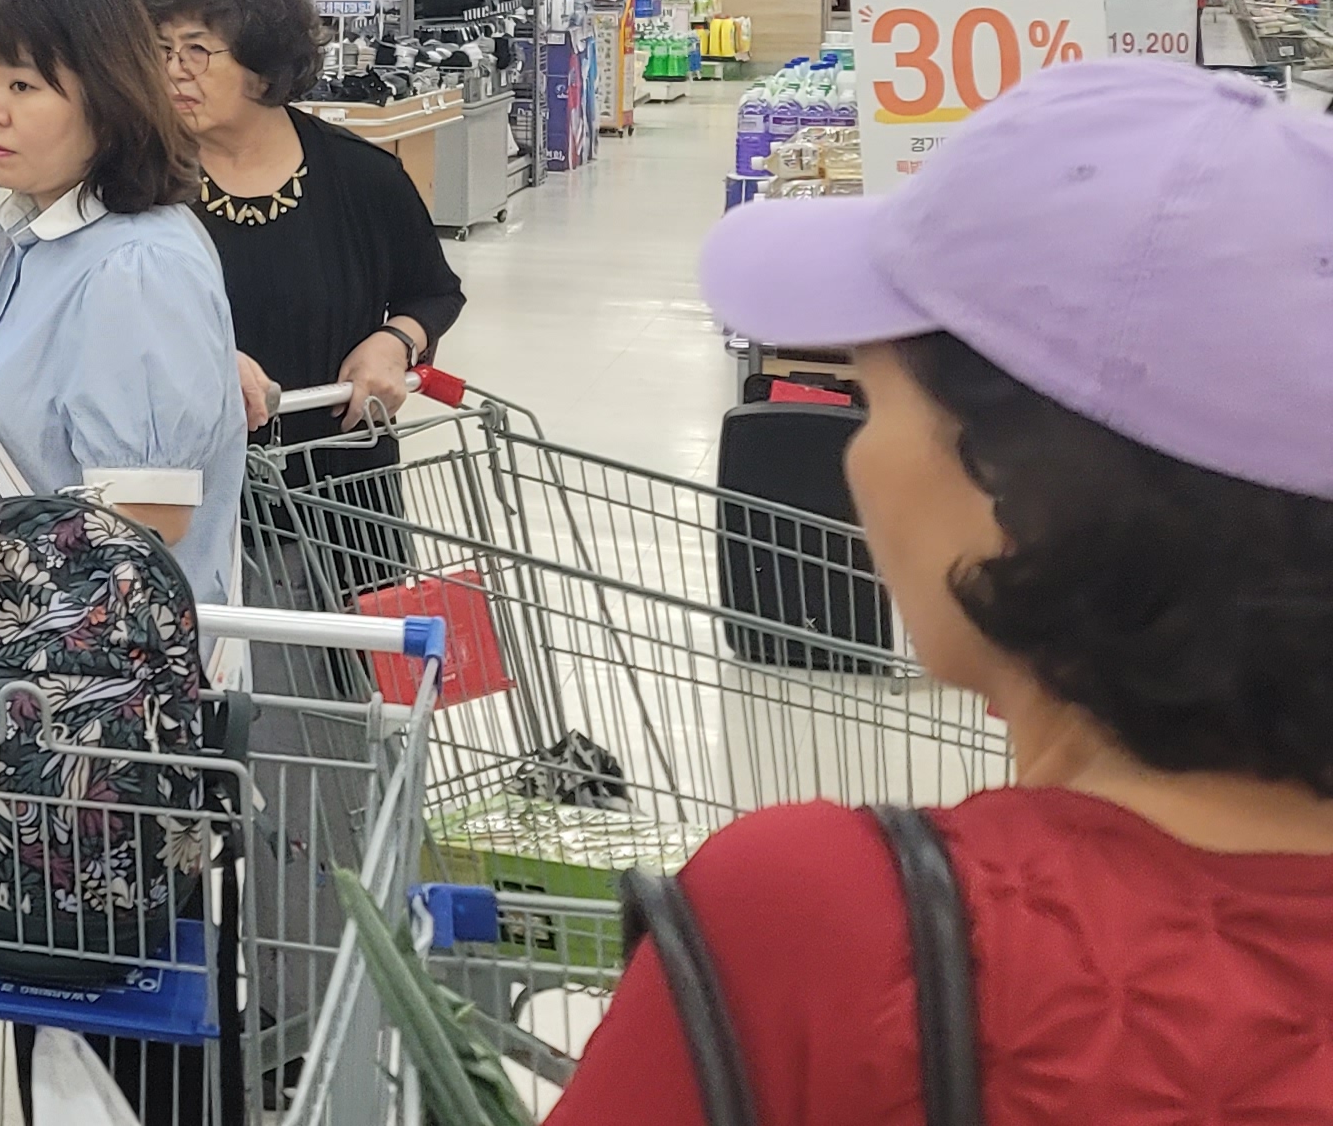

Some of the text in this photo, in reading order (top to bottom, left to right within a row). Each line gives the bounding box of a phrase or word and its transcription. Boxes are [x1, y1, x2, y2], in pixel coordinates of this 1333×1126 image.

[1108, 32, 1189, 56] 19,200
[871, 6, 1083, 117] 30%
[20, 984, 84, 1001] WARNING
